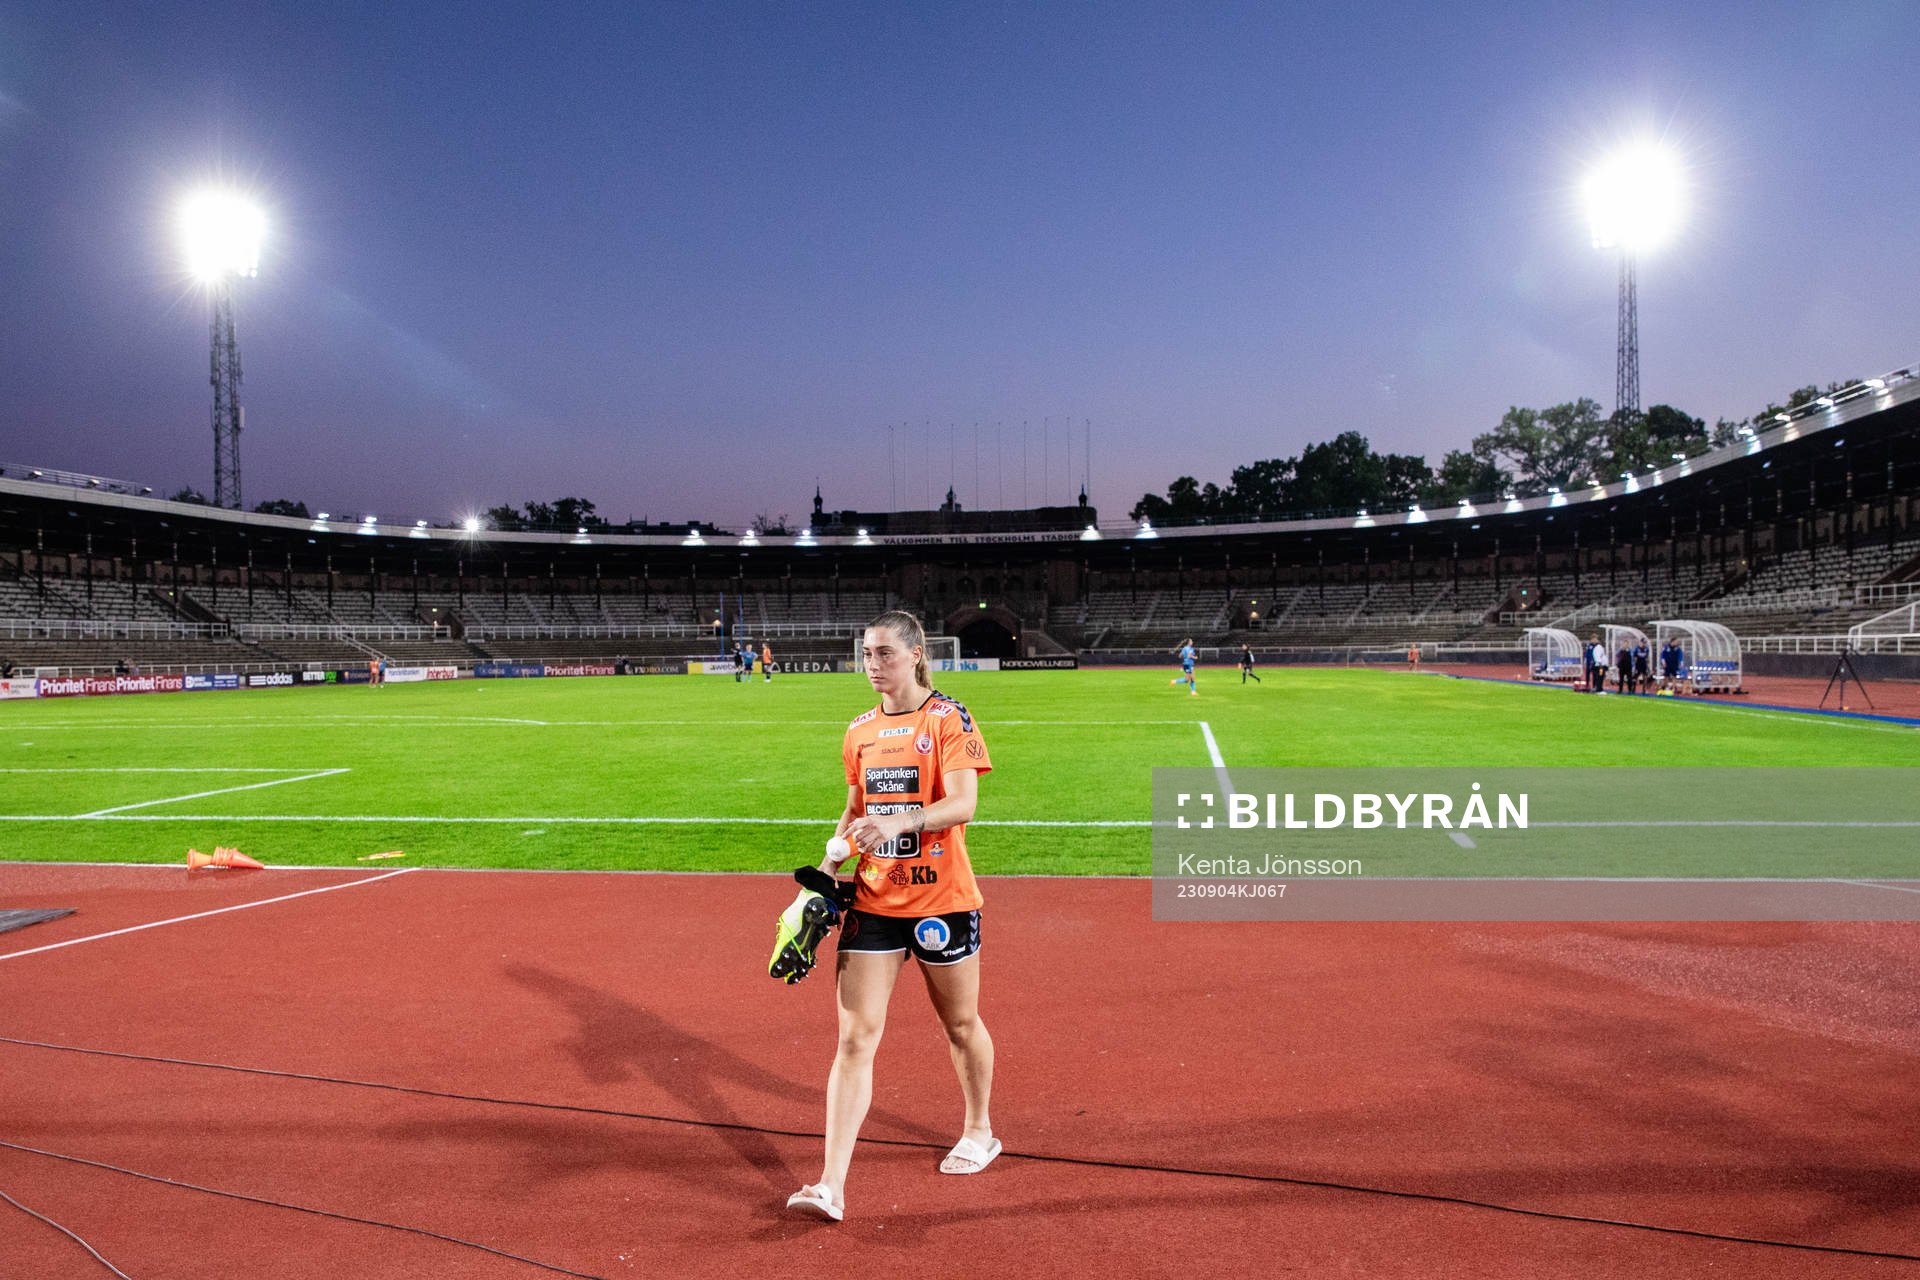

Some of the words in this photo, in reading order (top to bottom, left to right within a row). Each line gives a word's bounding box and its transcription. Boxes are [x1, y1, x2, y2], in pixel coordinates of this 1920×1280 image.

[975, 535, 1035, 543] STOCKHOLMS
[544, 666, 584, 676] Prioritet
[585, 664, 616, 675] Finans
[784, 661, 831, 672] ELEDA
[40, 678, 85, 694] Prioritet
[85, 677, 116, 692] Finans
[116, 675, 154, 691] Prioritet
[155, 674, 183, 690] Finans
[266, 672, 293, 685] adidas
[866, 768, 918, 782] Sparbanken
[877, 780, 905, 793] Skåne
[910, 865, 938, 885] Kb
